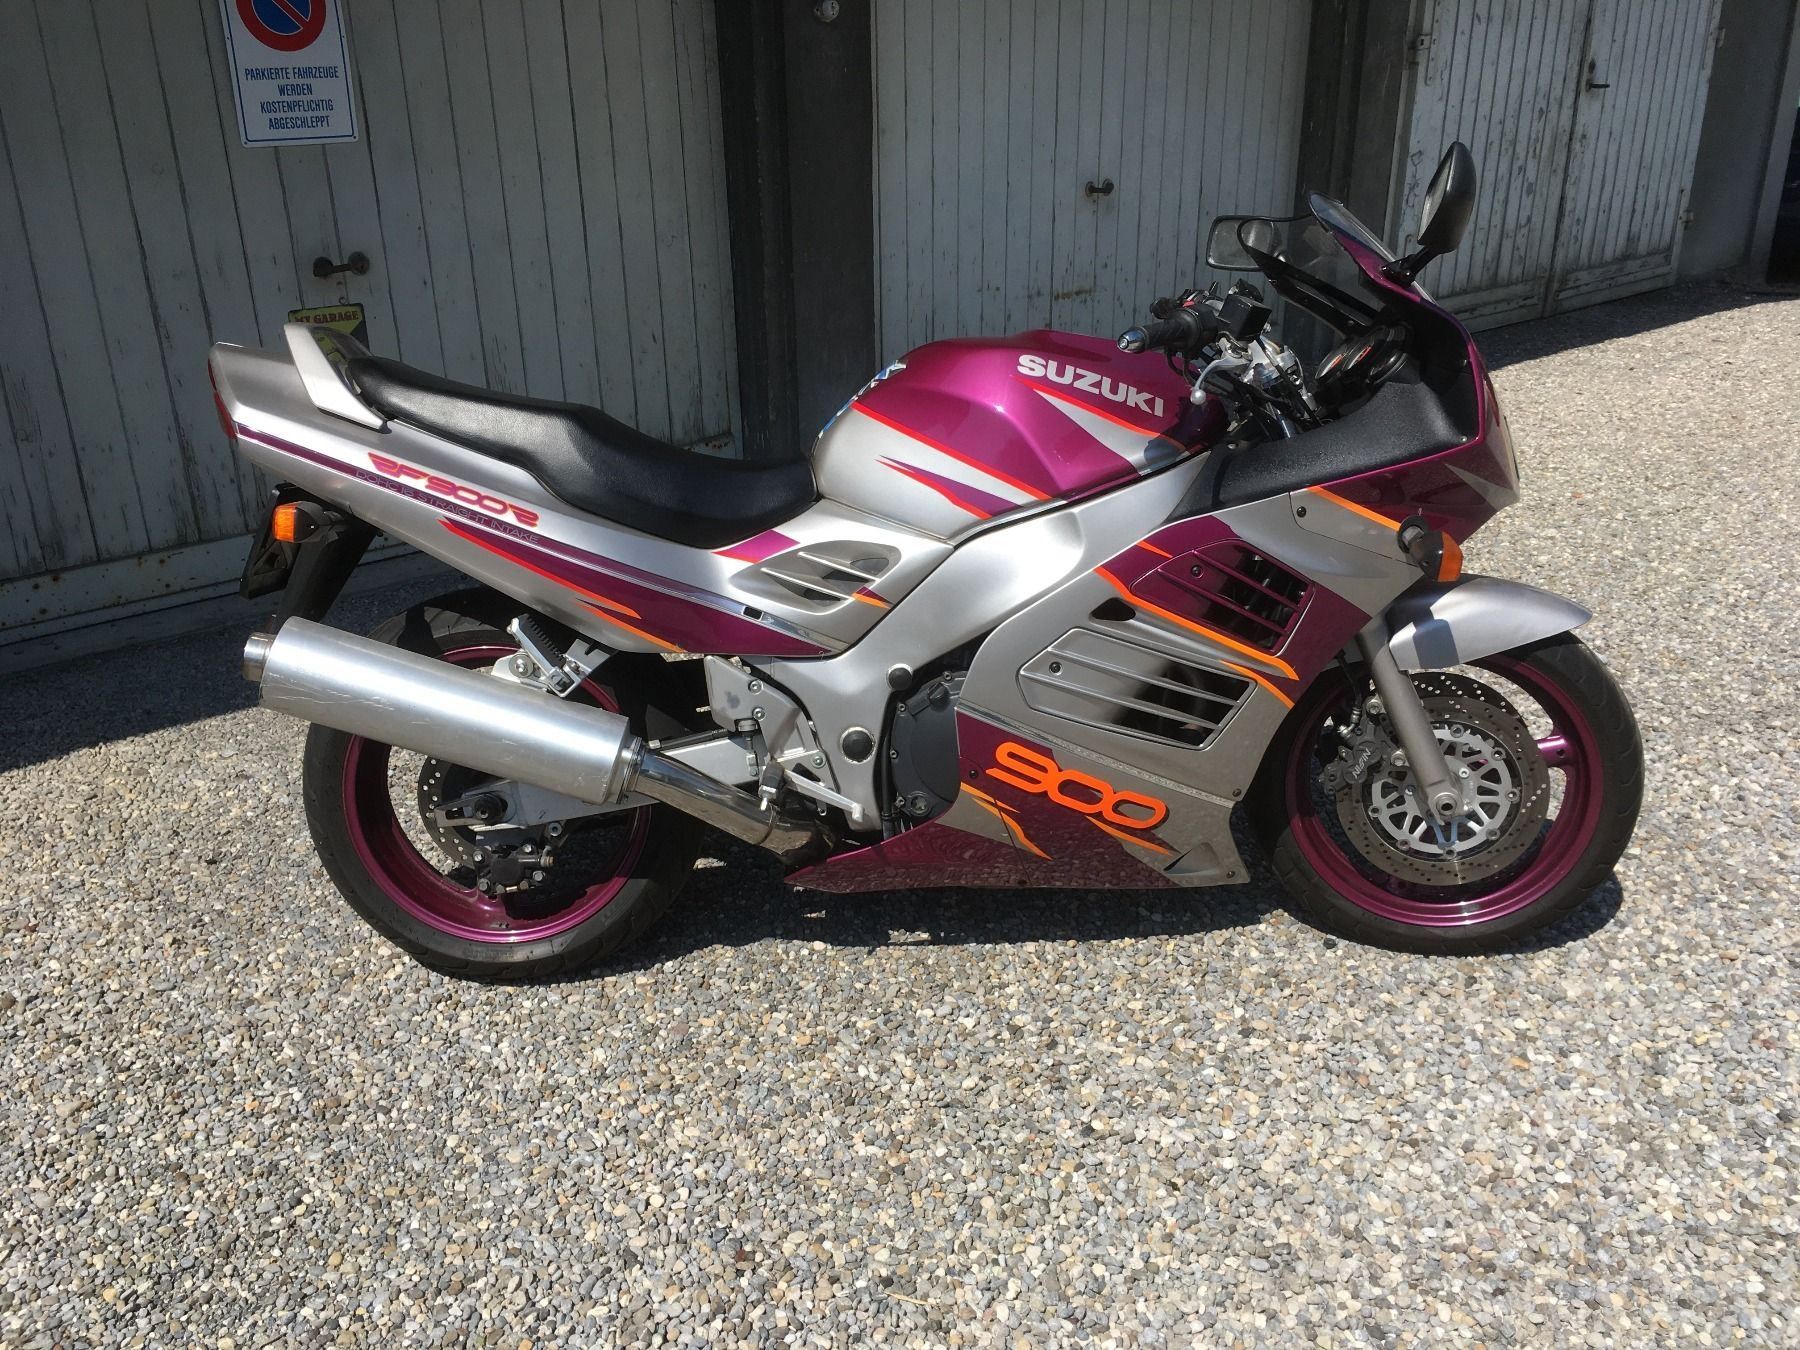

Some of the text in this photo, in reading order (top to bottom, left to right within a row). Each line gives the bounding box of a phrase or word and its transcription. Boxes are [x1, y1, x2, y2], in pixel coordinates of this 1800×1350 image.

[244, 66, 340, 81] PARKIERTE FAHRZEUGE
[277, 83, 313, 97] WERDEN
[260, 99, 334, 114] KOSTENPFLICHTIG
[268, 115, 330, 130] ABGESCHLEPPT
[313, 310, 360, 324] GARAGE
[1016, 354, 1164, 418] SUZUKI
[355, 470, 539, 544] DOHC 16 STRAIGHT INTAKE
[985, 741, 1168, 829] 900
